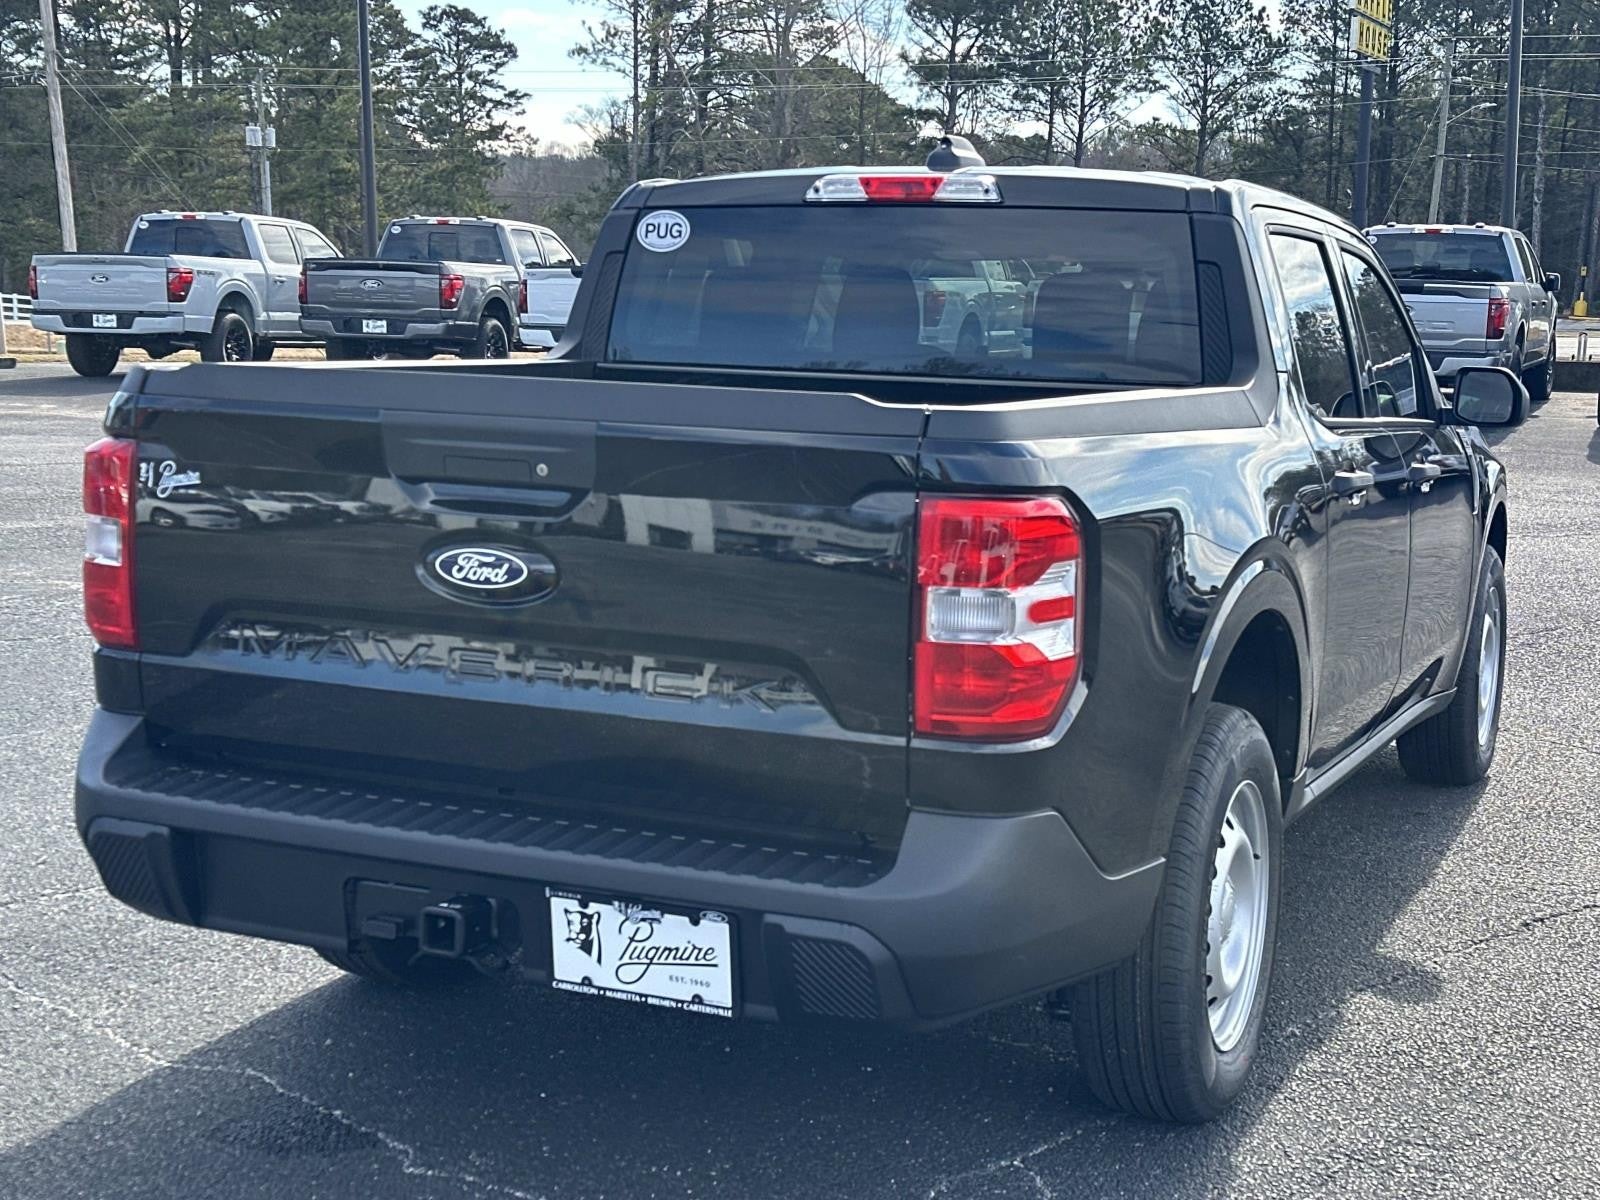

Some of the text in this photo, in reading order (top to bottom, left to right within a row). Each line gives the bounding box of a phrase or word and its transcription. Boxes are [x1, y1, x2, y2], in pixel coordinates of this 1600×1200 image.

[1359, 21, 1387, 56] HOUSE
[645, 222, 683, 239] PUG
[451, 552, 509, 583] Ford
[237, 622, 778, 712] MAVERICK
[615, 917, 719, 984] Pugmire
[605, 989, 641, 1002] MARIETTA
[647, 996, 677, 1008] BREMEN
[683, 1002, 732, 1017] CARTERSVILLE
